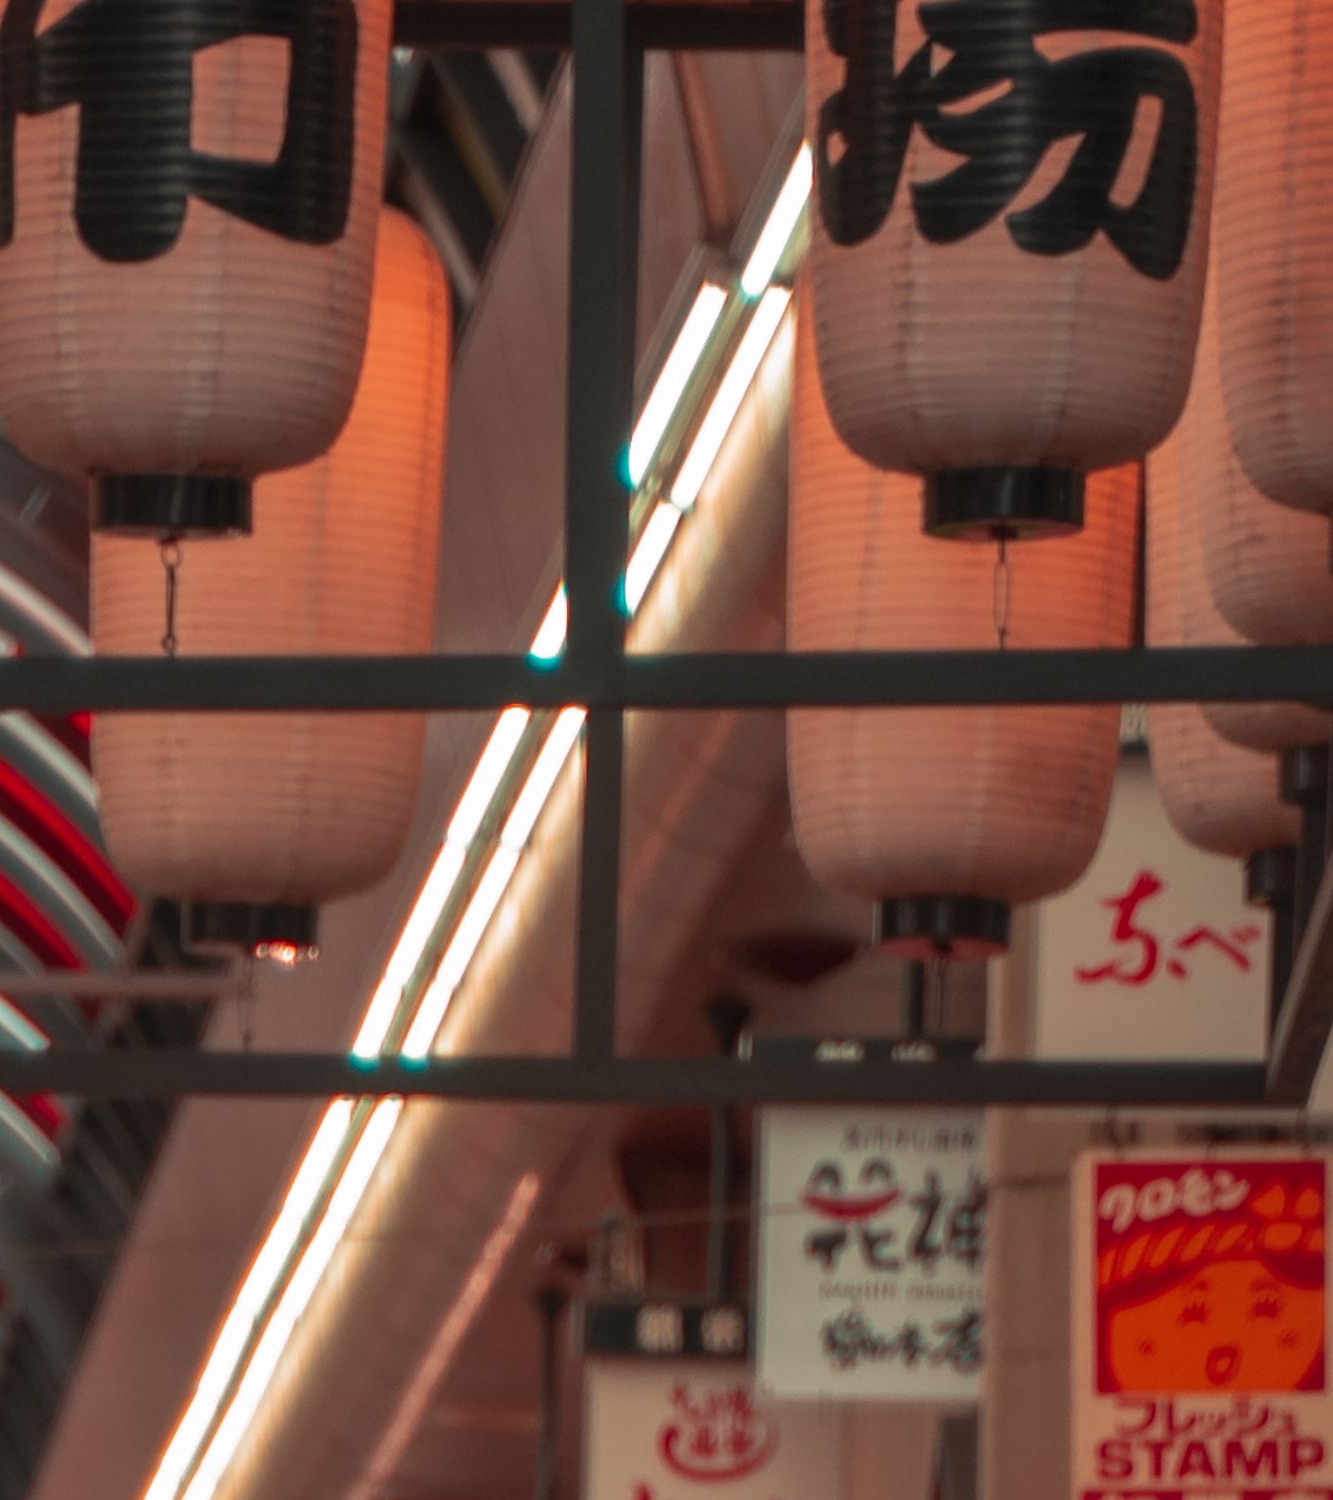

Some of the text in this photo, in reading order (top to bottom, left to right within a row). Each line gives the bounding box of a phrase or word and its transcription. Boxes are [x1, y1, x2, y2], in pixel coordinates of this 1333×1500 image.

[1099, 1167, 1251, 1235] クロモン
[1094, 1439, 1326, 1480] STAMP
